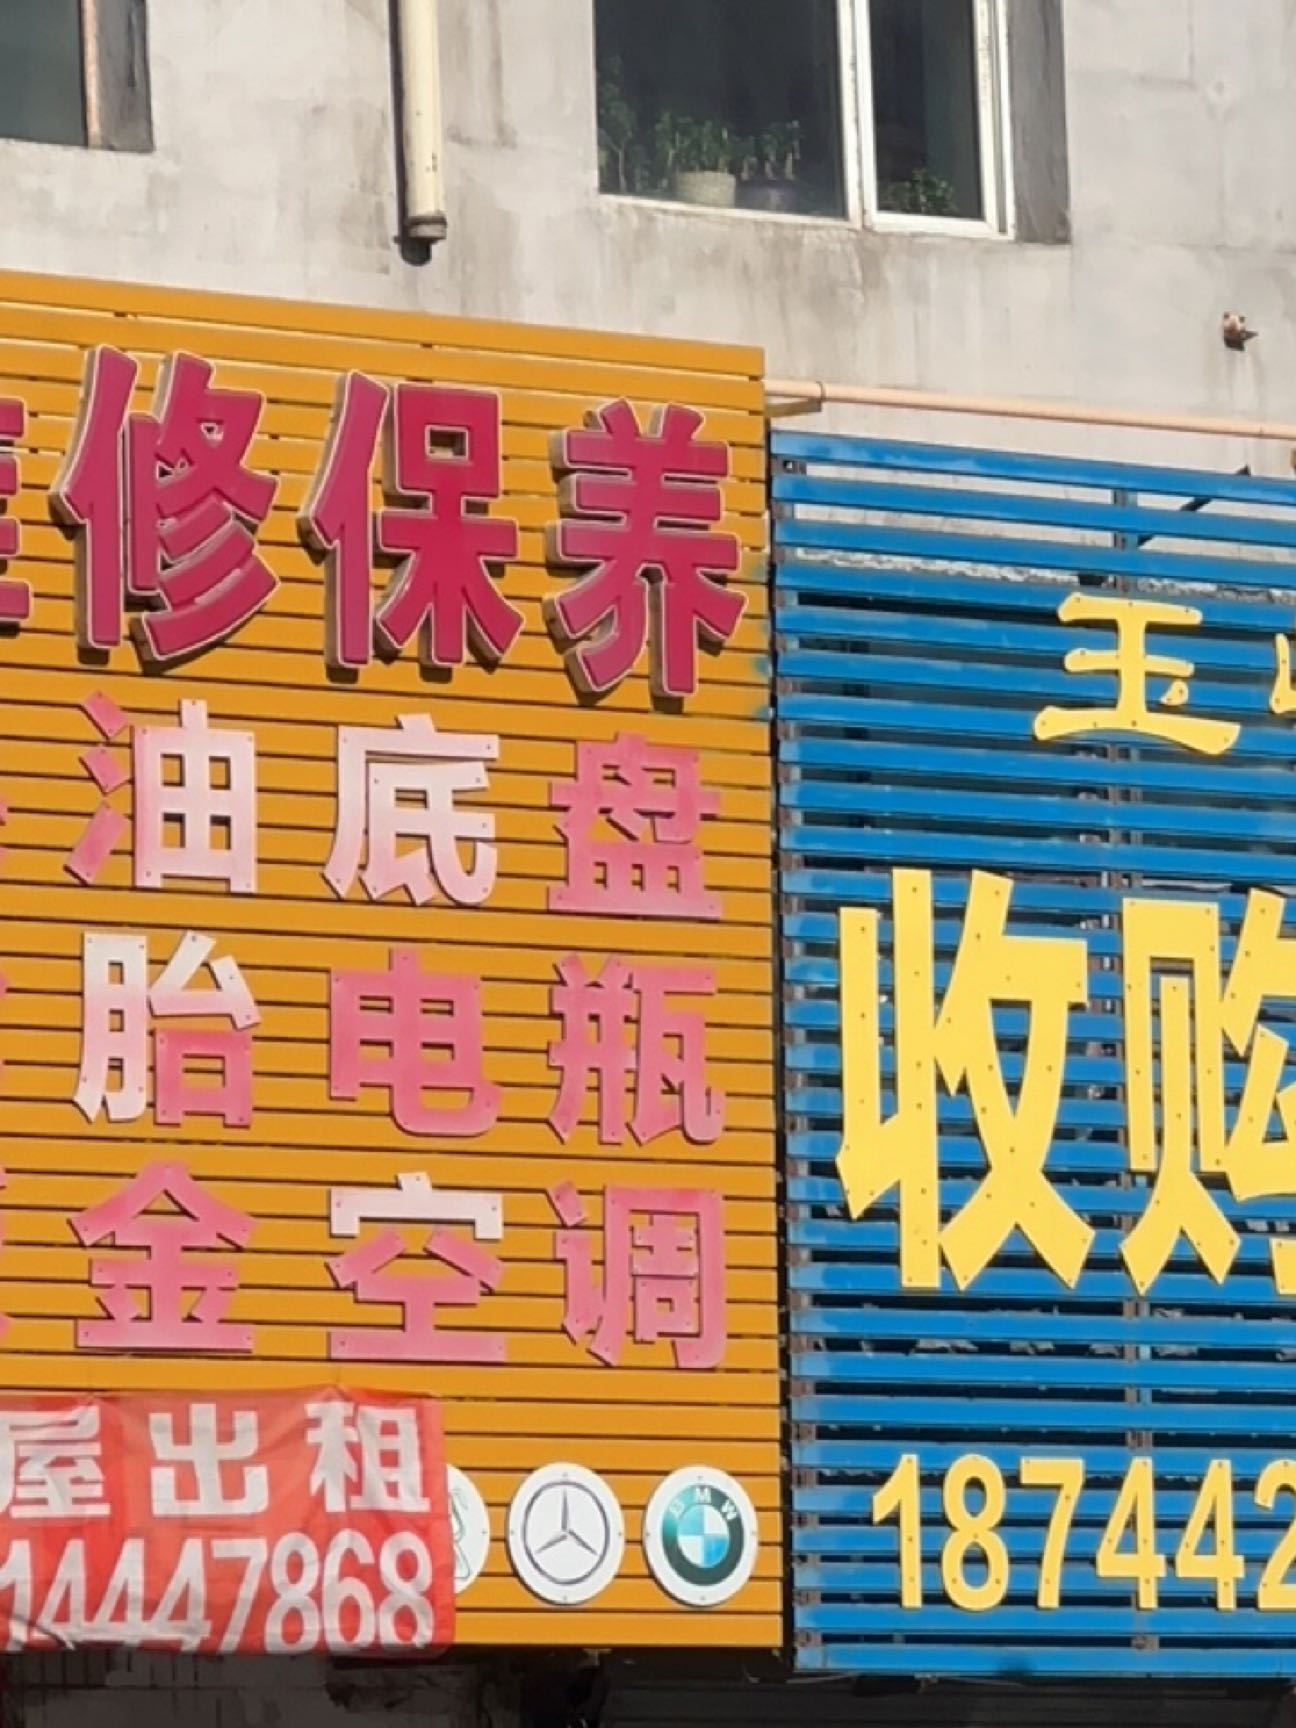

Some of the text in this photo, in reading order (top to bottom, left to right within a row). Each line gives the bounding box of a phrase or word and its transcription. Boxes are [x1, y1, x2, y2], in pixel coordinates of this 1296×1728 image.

[0, 345, 748, 702] 修保养
[0, 690, 723, 920] 油底盘
[0, 929, 727, 1146] 胎电瓶
[0, 1159, 728, 1370] 金空调
[0, 1402, 430, 1517] 屋出租
[0, 1529, 434, 1653] 14447868
